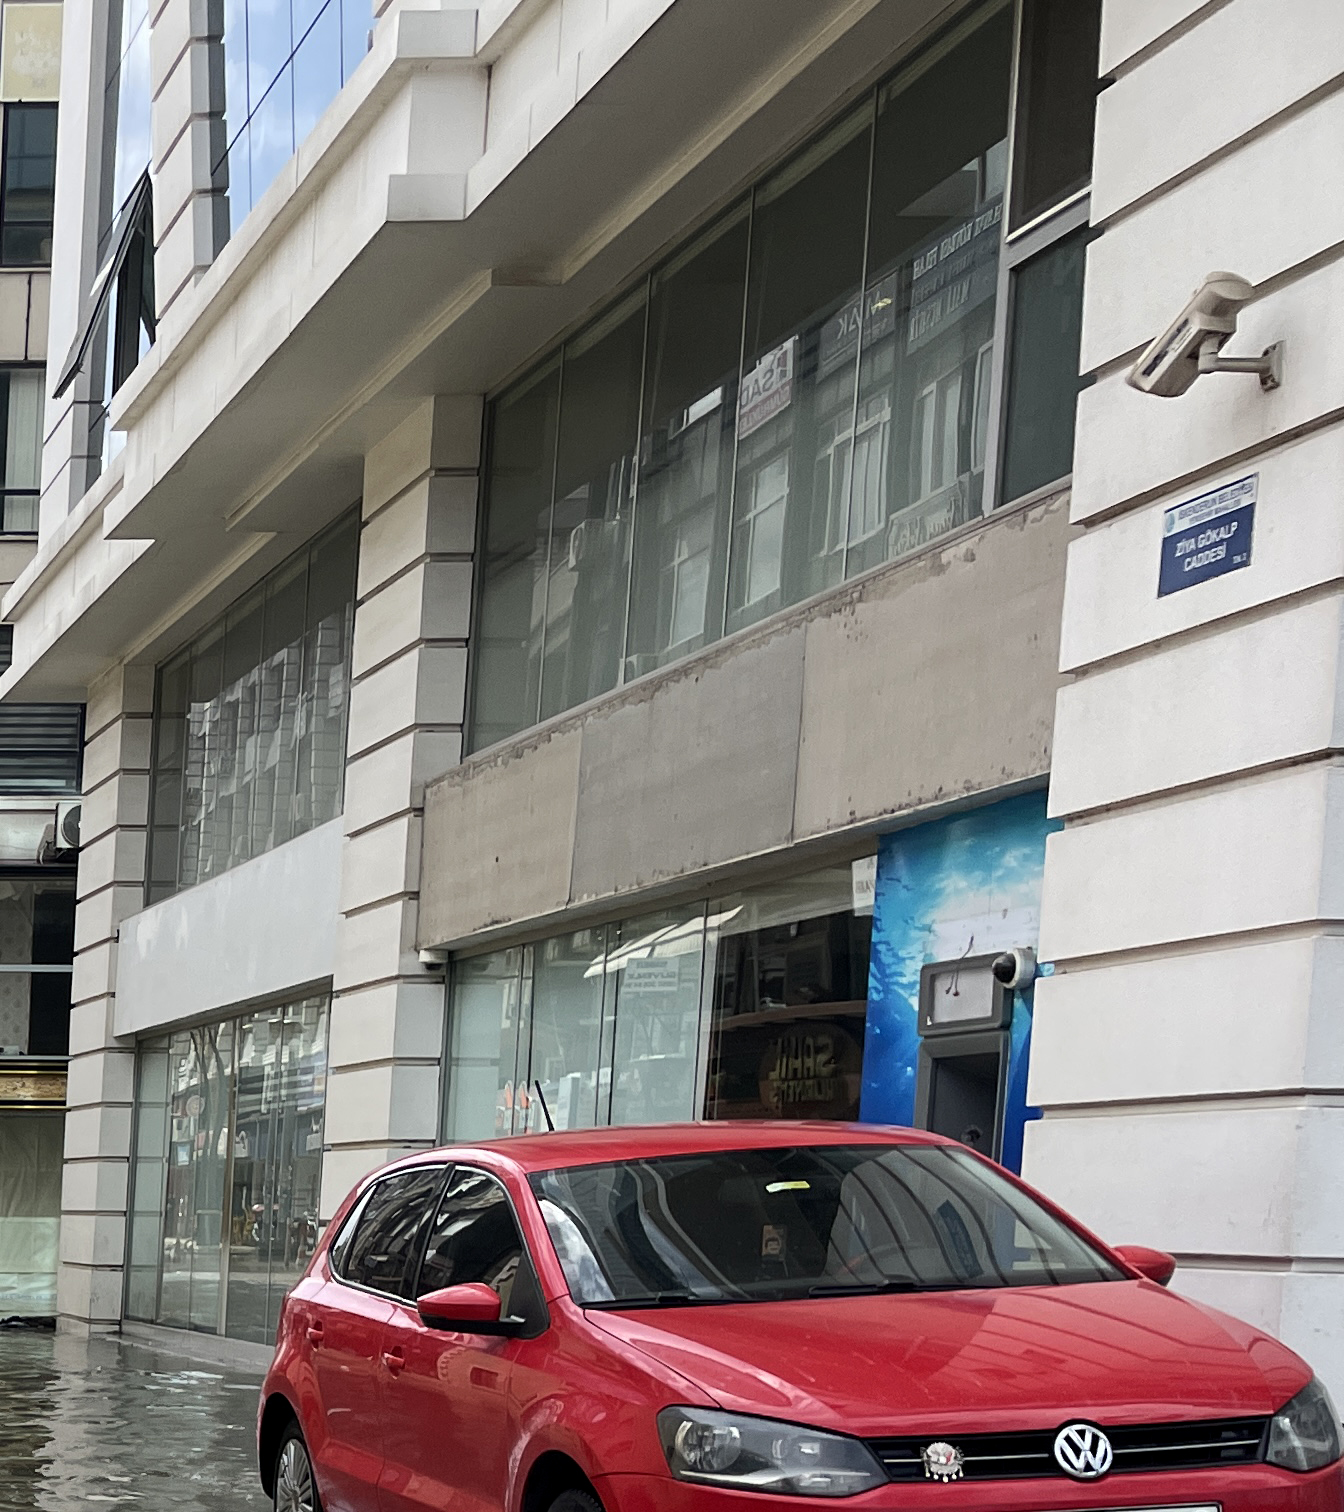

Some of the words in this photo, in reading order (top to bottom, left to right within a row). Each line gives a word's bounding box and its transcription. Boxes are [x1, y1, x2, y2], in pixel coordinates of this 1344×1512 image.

[1175, 538, 1196, 557] ZİYA
[1198, 521, 1237, 548] GÖKALP
[1183, 541, 1227, 572] CADDESİ
